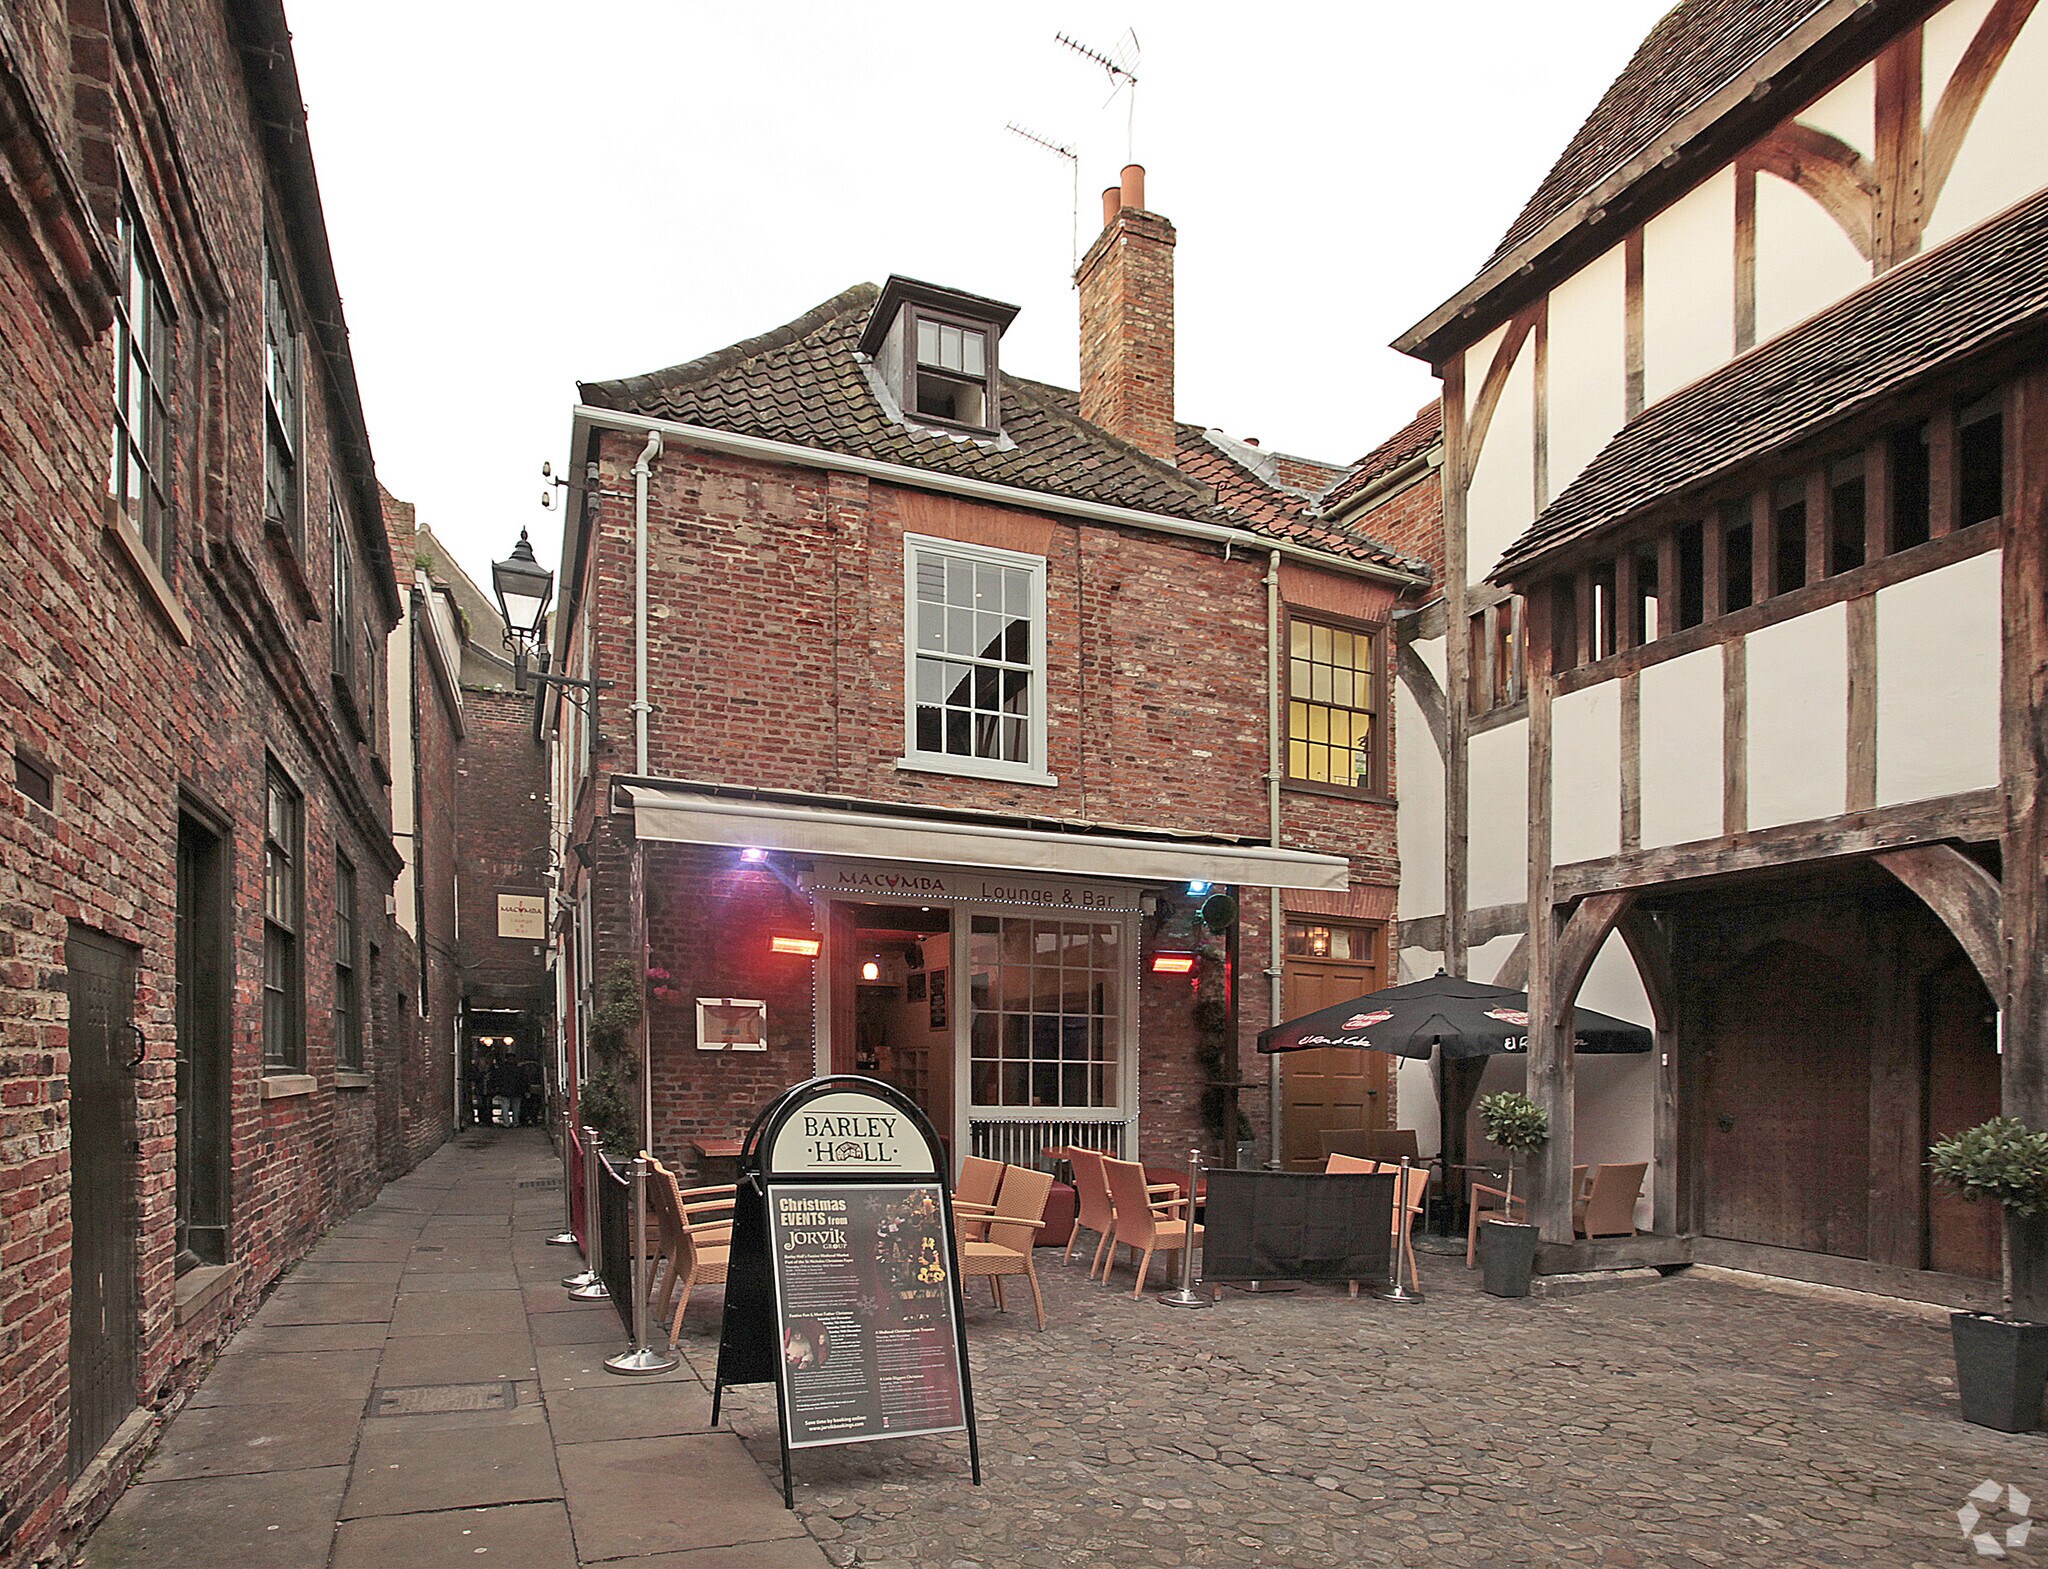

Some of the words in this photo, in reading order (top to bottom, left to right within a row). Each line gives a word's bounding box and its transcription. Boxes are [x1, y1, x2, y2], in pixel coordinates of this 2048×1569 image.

[981, 883, 1053, 904] Lounge
[1062, 889, 1073, 904] &
[1083, 891, 1114, 906] Bar
[804, 1117, 896, 1138] BARLEY
[780, 1198, 847, 1212] Christmas
[781, 1212, 826, 1226] EVENTS
[828, 1216, 848, 1225] from
